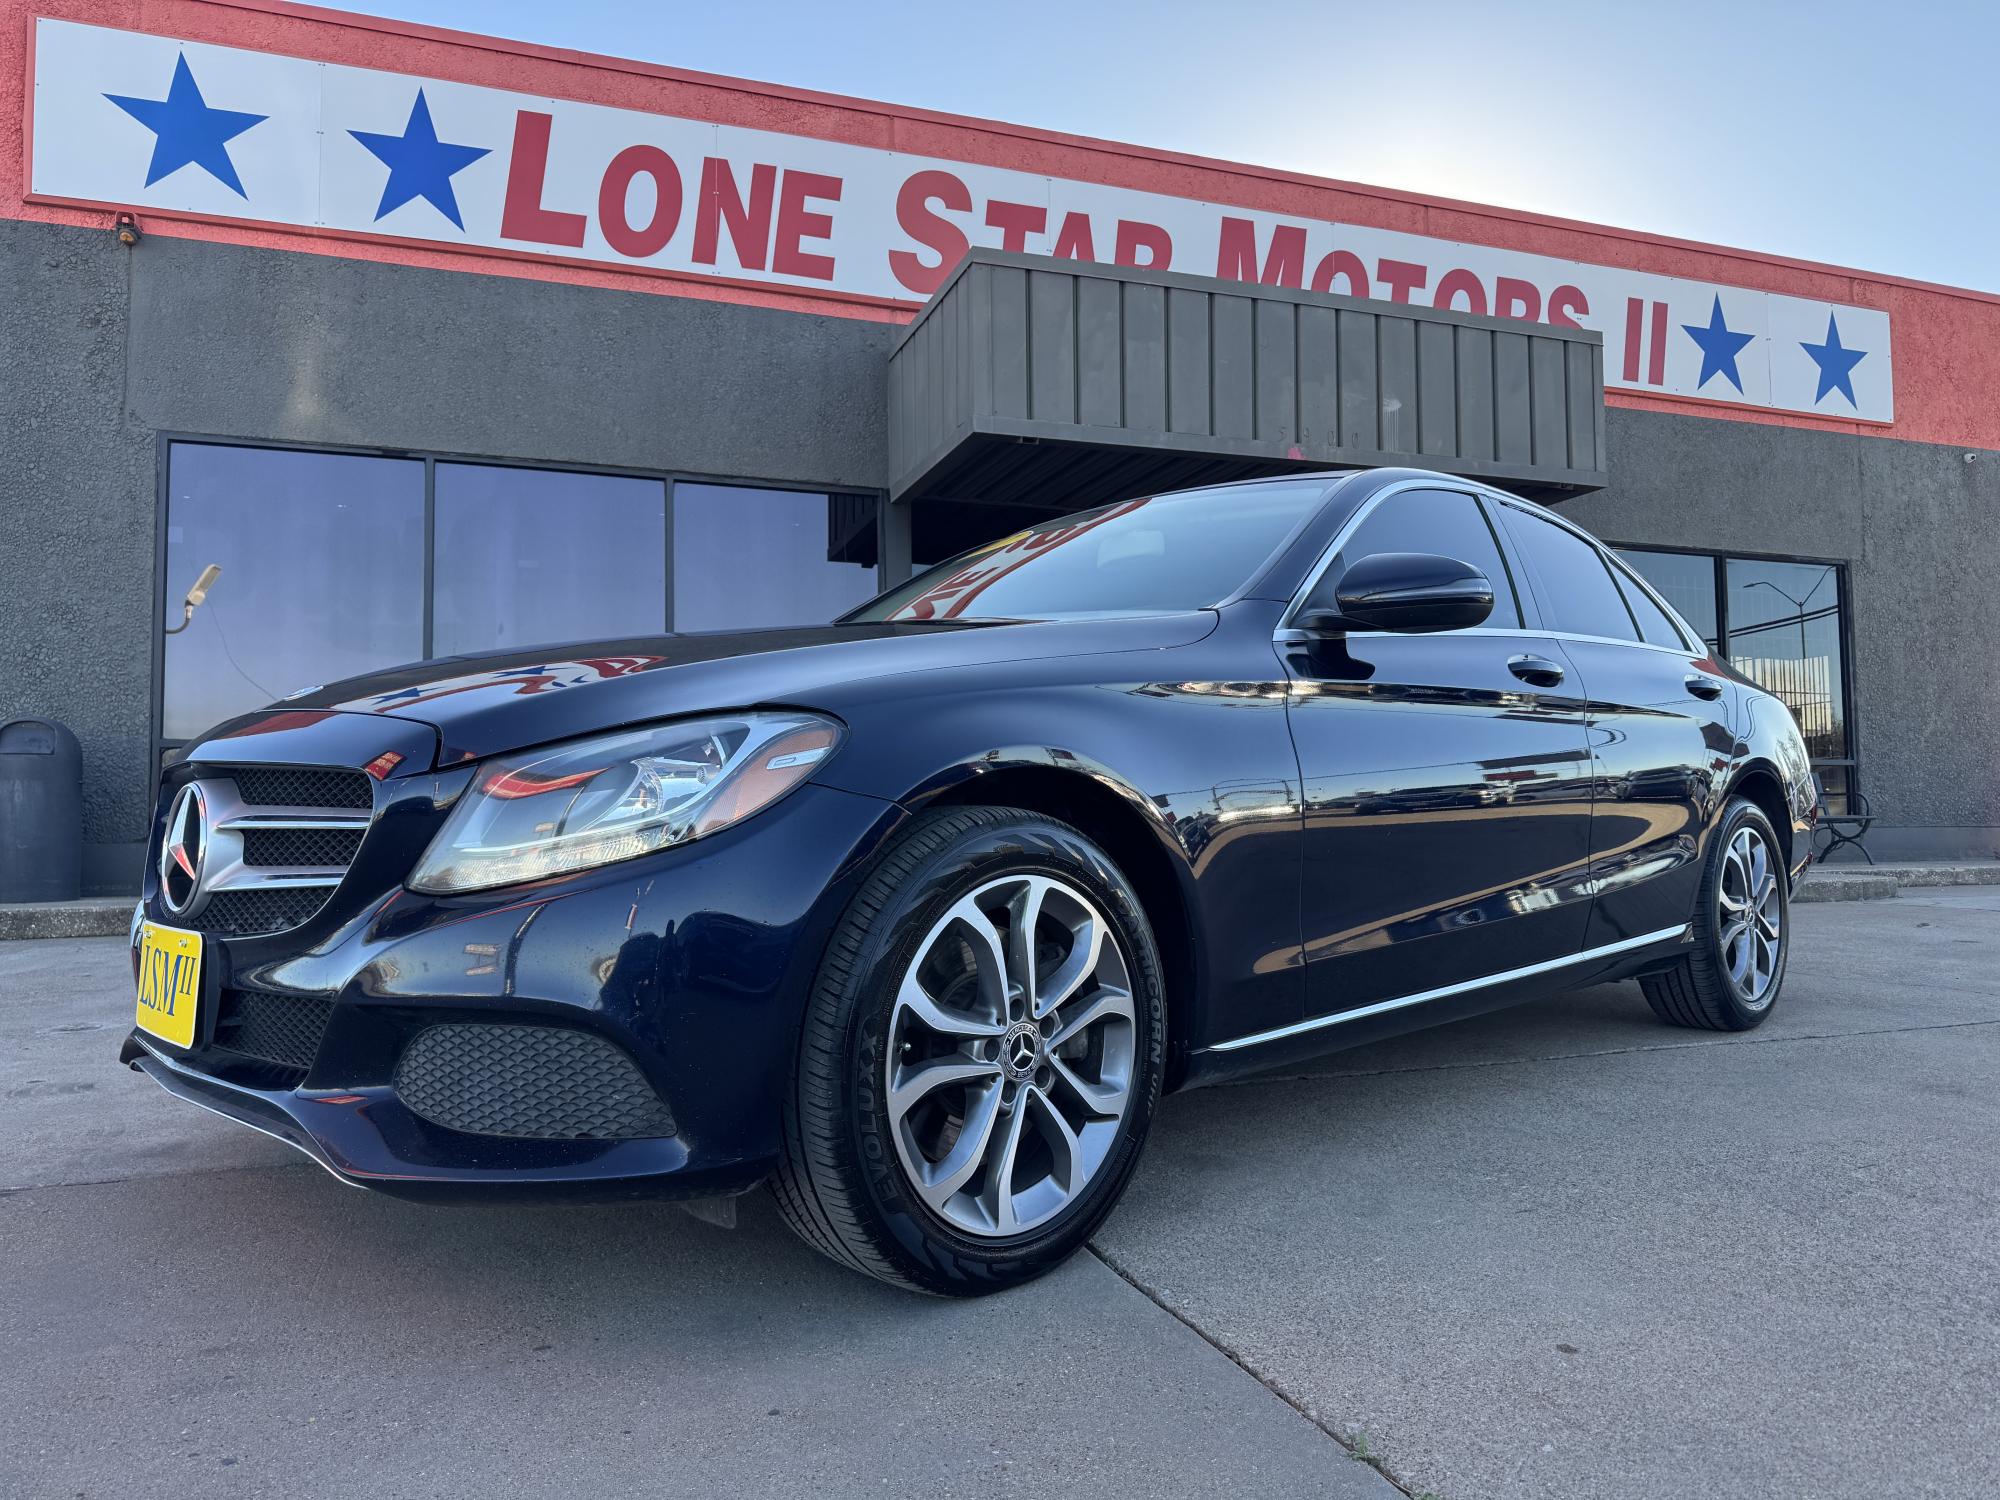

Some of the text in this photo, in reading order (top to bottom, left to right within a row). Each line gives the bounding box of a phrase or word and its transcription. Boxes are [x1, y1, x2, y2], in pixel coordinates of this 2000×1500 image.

[500, 110, 1668, 386] LONE STAR MOTORS II
[857, 1029, 899, 1201] EVOLUXX
